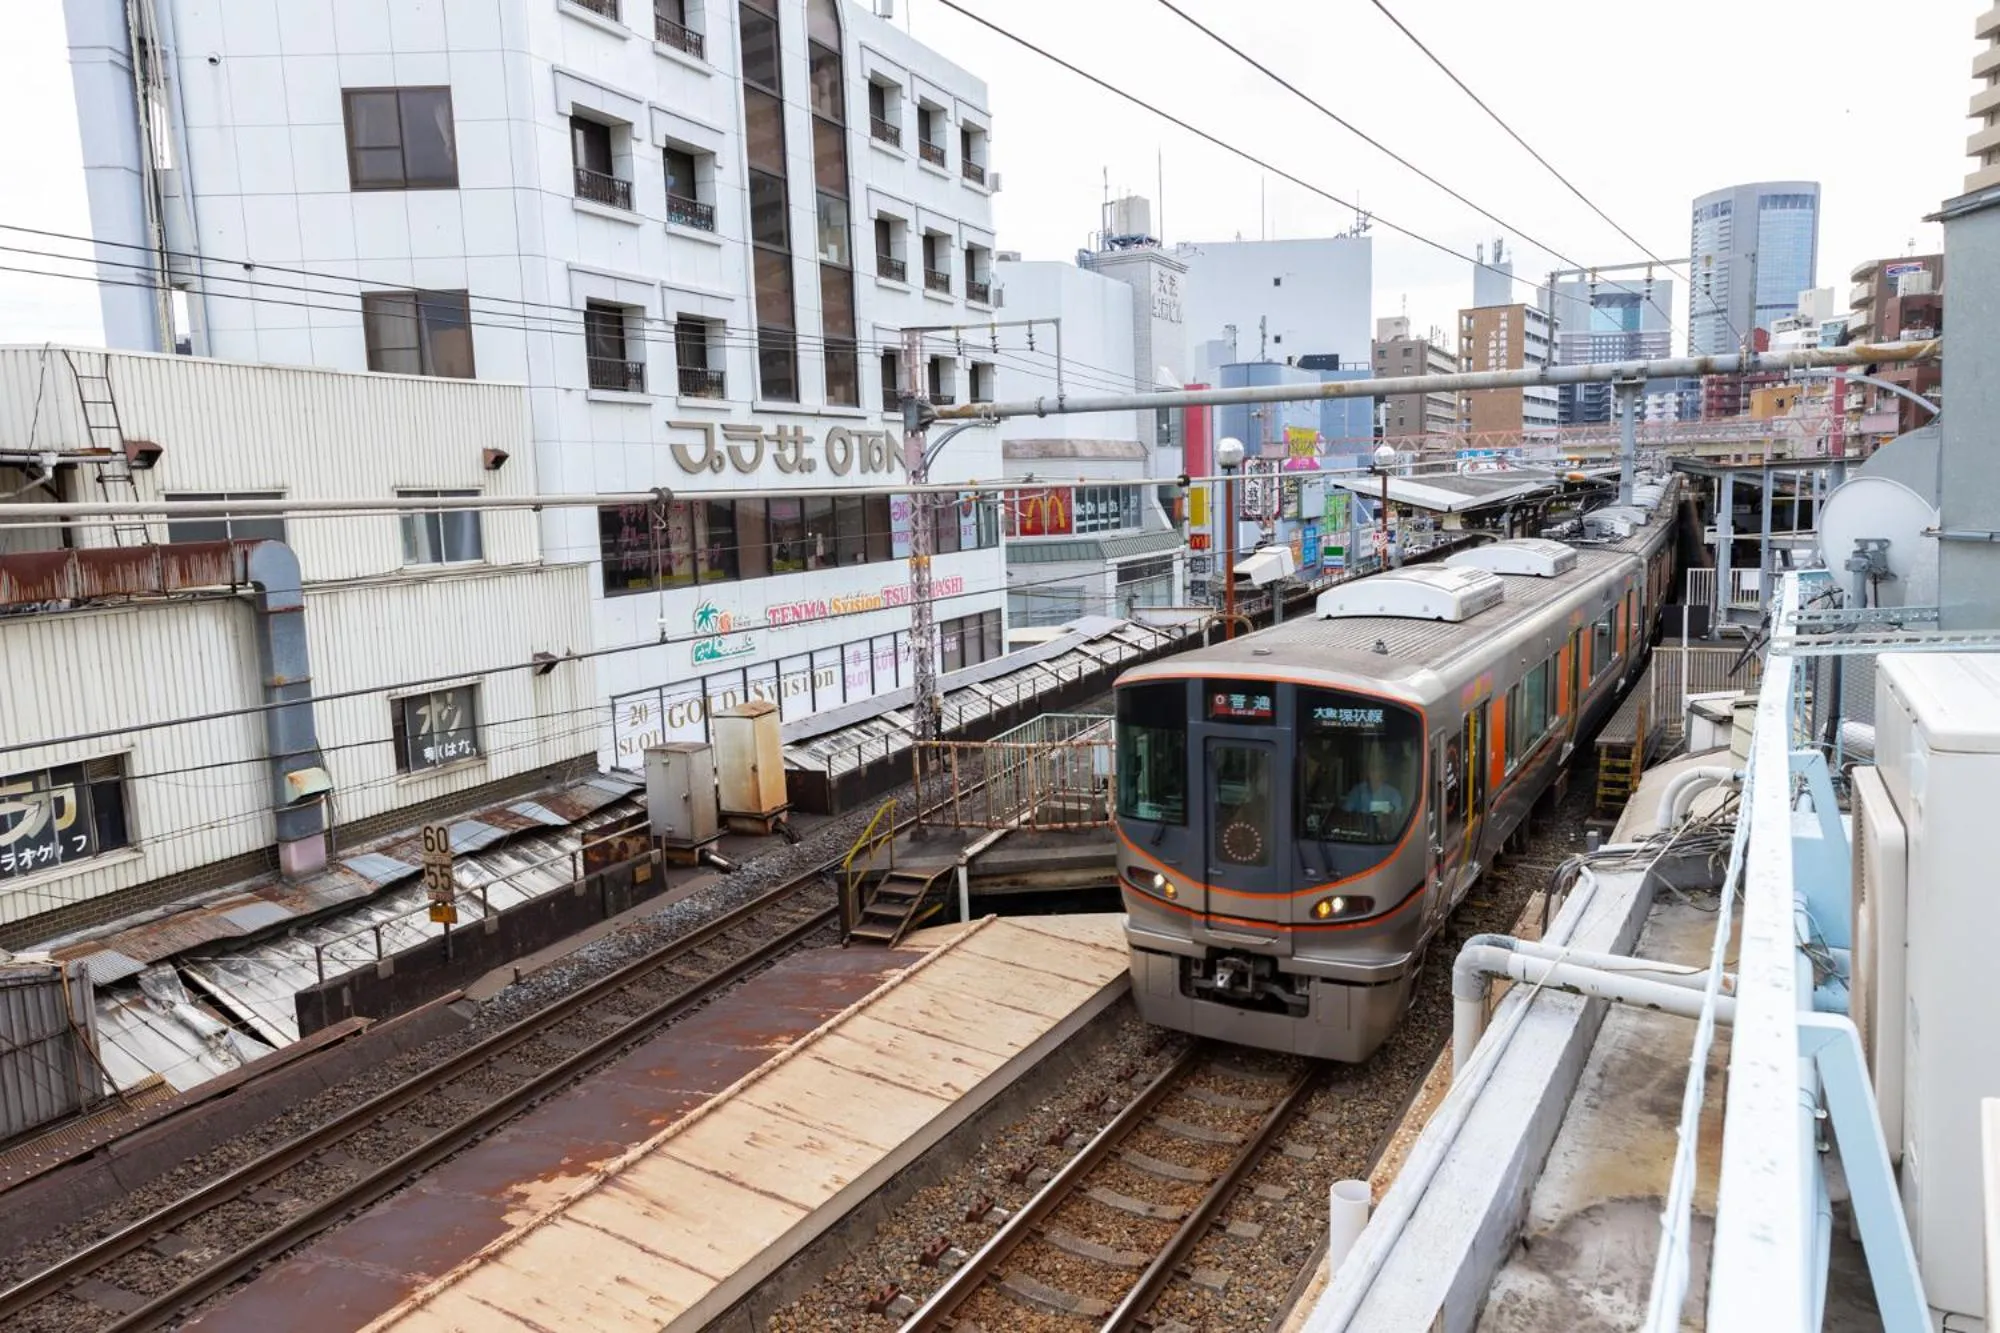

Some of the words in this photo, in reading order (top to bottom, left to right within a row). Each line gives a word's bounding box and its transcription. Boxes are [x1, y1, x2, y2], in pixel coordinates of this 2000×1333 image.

[767, 599, 828, 629] TENMA
[831, 594, 881, 616] Svision
[629, 703, 649, 727] 20
[668, 689, 737, 729] GOLD
[618, 729, 662, 758] SLOT
[423, 826, 449, 853] 60
[426, 862, 452, 891] 55
